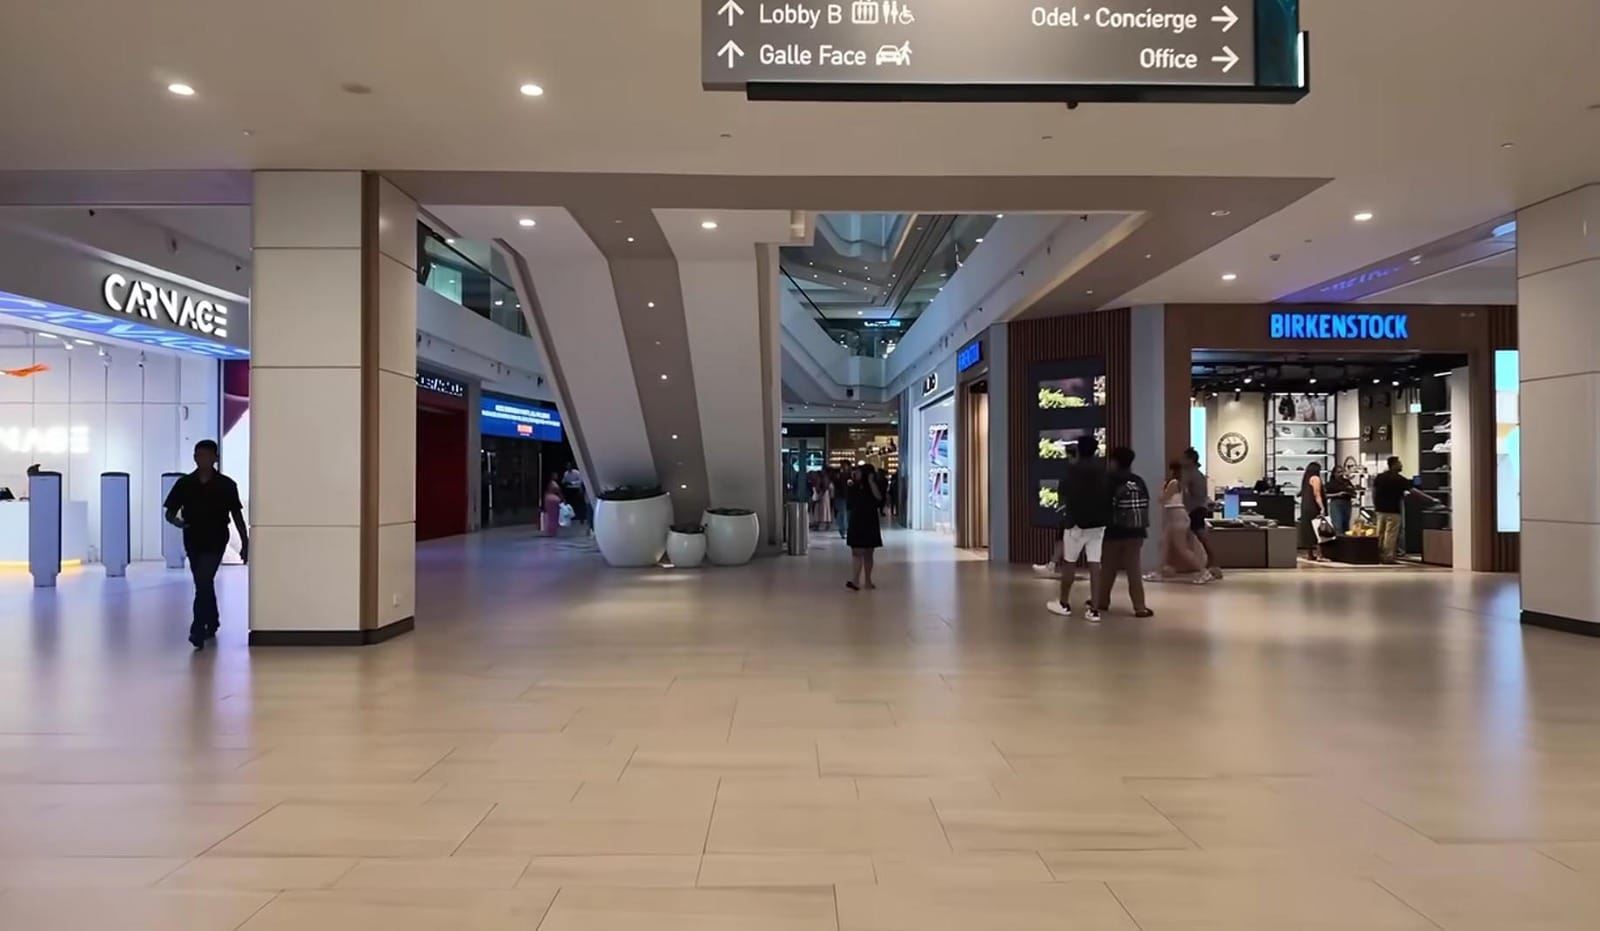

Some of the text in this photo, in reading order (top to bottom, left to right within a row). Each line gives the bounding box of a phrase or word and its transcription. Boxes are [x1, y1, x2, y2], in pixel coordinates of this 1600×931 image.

[759, 3, 842, 29] Lobby B
[1031, 6, 1198, 34] Odel Concierge
[759, 43, 867, 66] Galle Face
[1139, 48, 1198, 69] Office
[1270, 313, 1409, 340] BIRKENSTOCK
